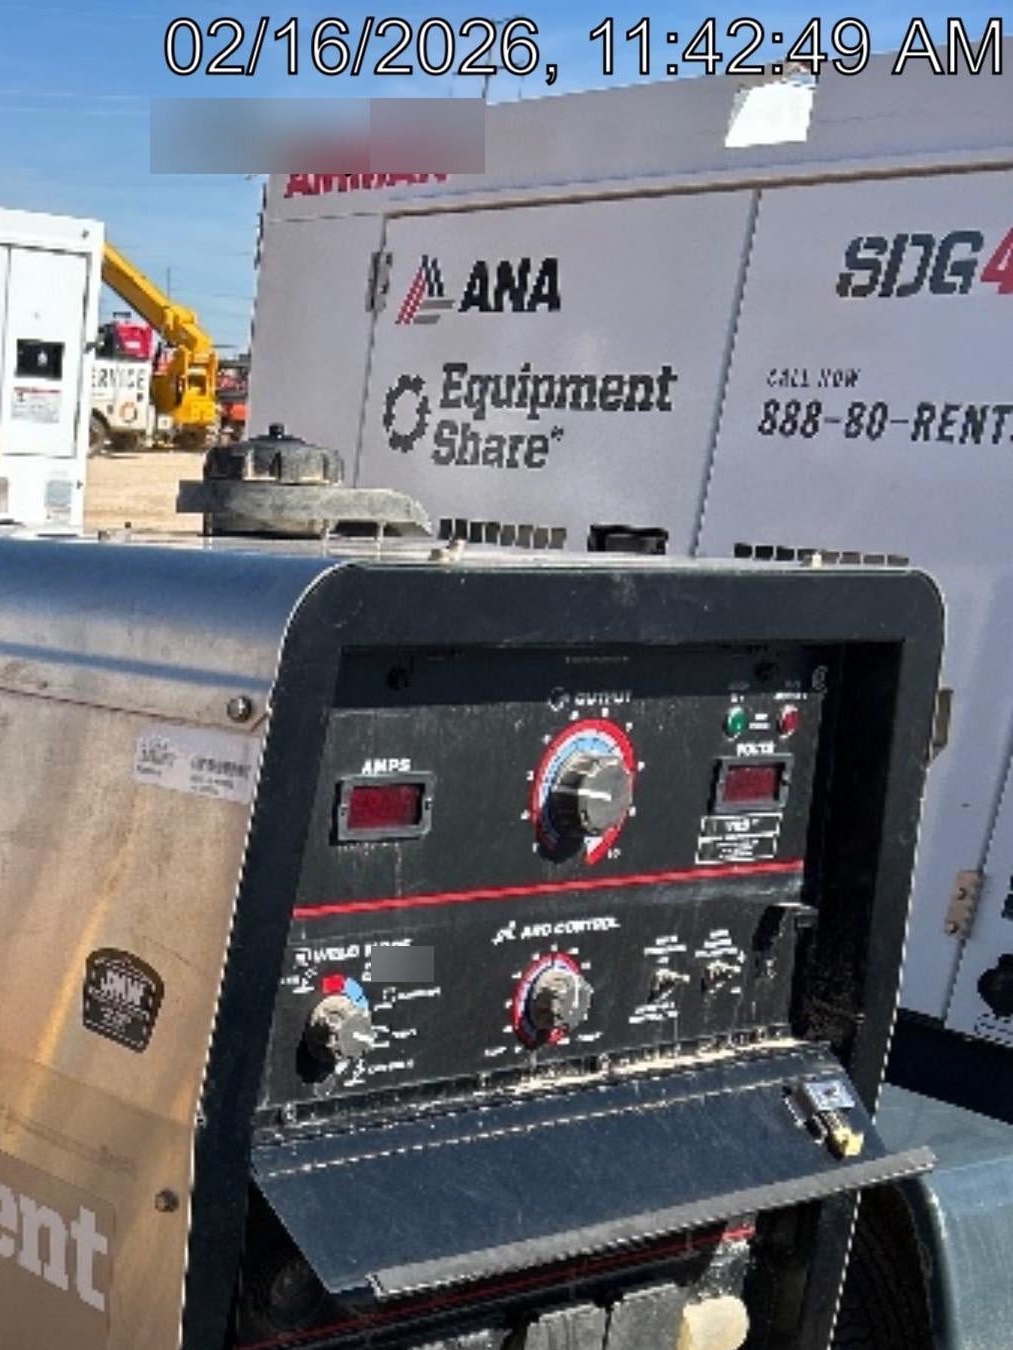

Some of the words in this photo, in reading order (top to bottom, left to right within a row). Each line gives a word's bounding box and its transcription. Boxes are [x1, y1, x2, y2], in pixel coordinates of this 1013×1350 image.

[458, 257, 561, 312] ANA
[766, 368, 811, 388] CALL
[817, 368, 861, 388] NOW
[440, 362, 678, 420] Equipment
[758, 398, 1013, 444] 888-80-RENT
[574, 690, 633, 707] OUTPUT
[361, 757, 412, 777] AMPS
[314, 943, 360, 963] WELD
